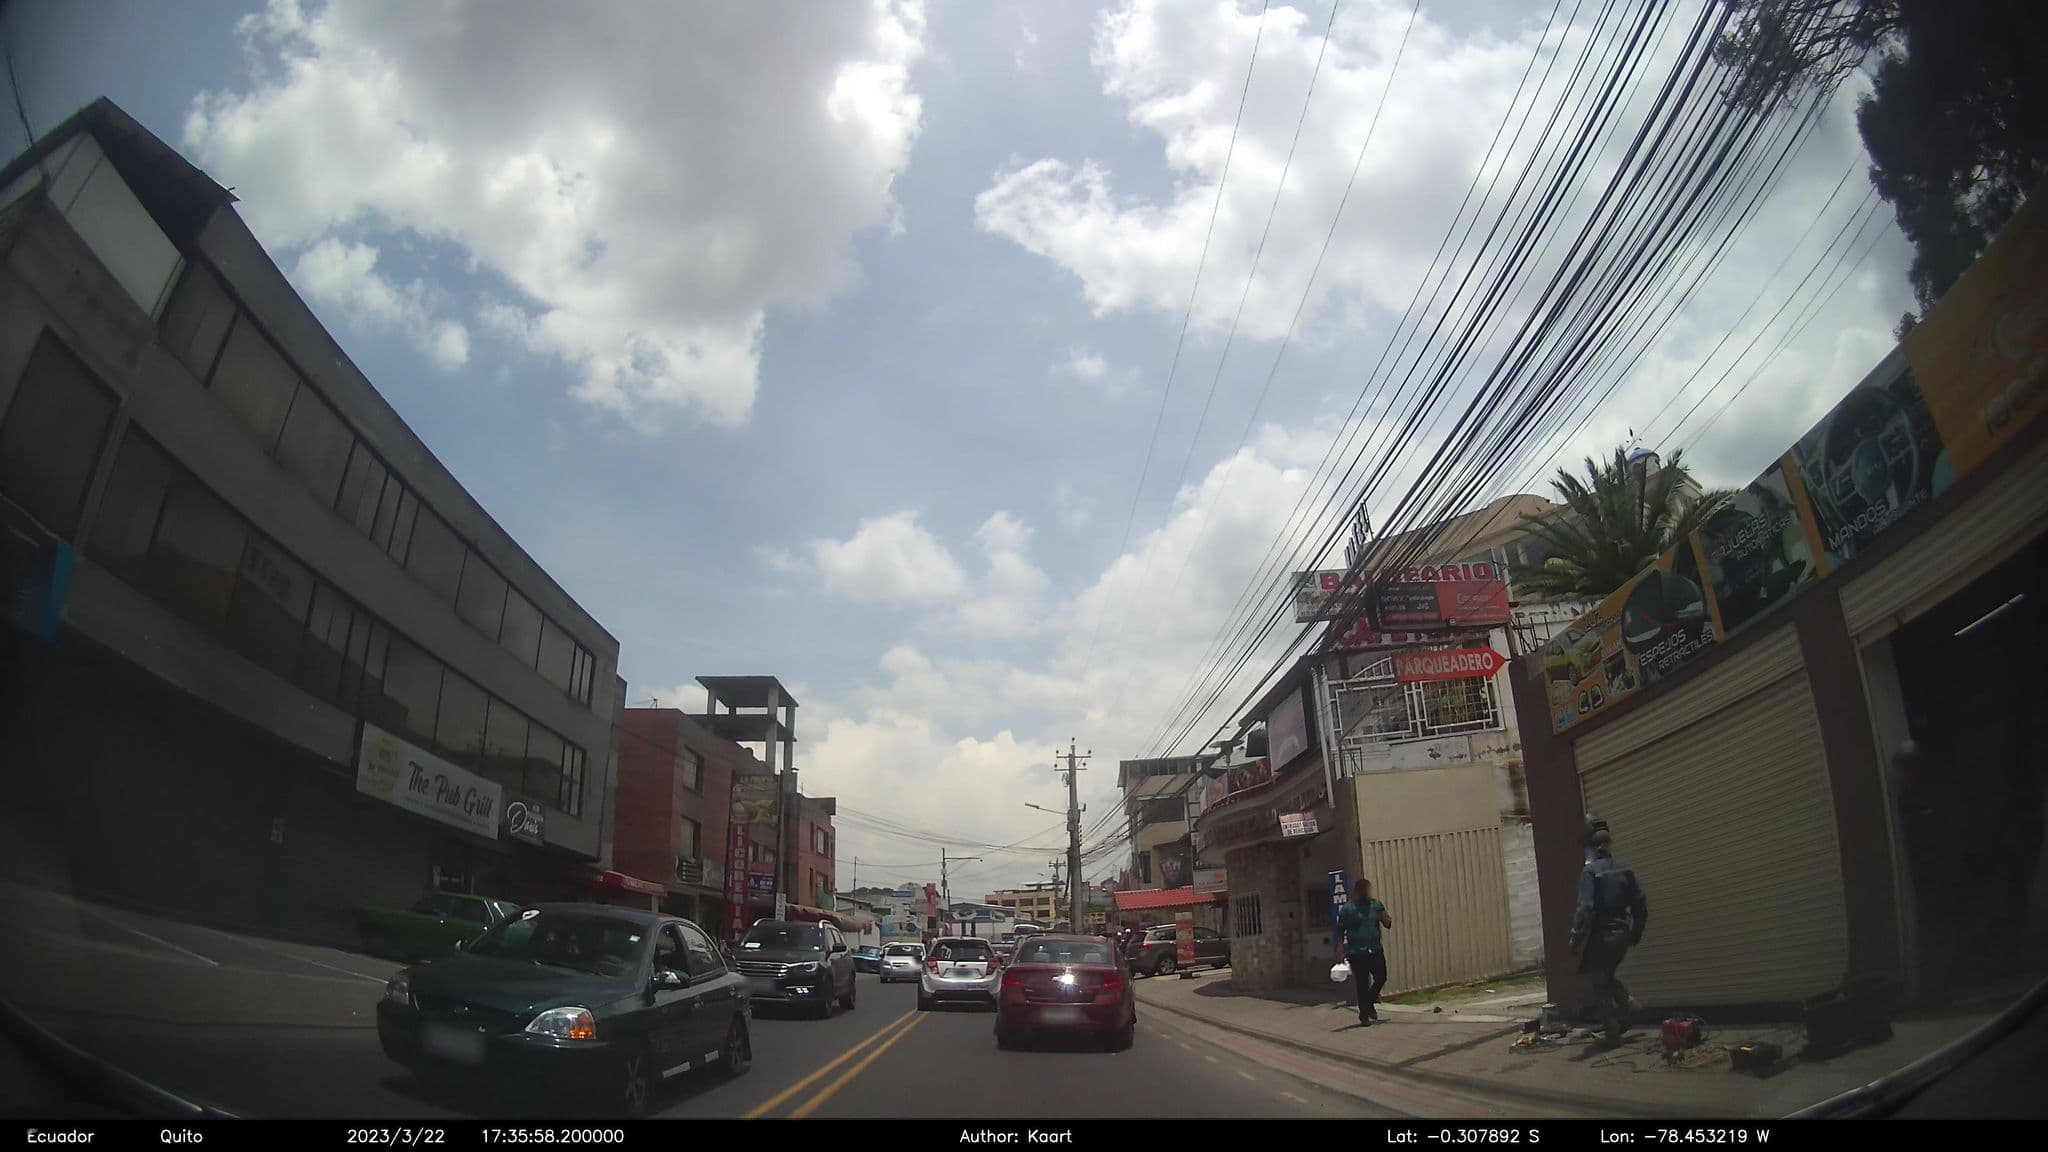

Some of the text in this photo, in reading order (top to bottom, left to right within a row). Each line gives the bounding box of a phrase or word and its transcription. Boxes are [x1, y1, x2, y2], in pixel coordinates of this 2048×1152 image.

[1827, 496, 1889, 551] MANDOS
[1318, 563, 1493, 590] BAEARIO
[1396, 652, 1494, 678] PARQUEADERO
[1639, 628, 1687, 666] ESPEJOS
[407, 761, 430, 794] The
[434, 774, 460, 806] Pub
[464, 787, 493, 819] Grill
